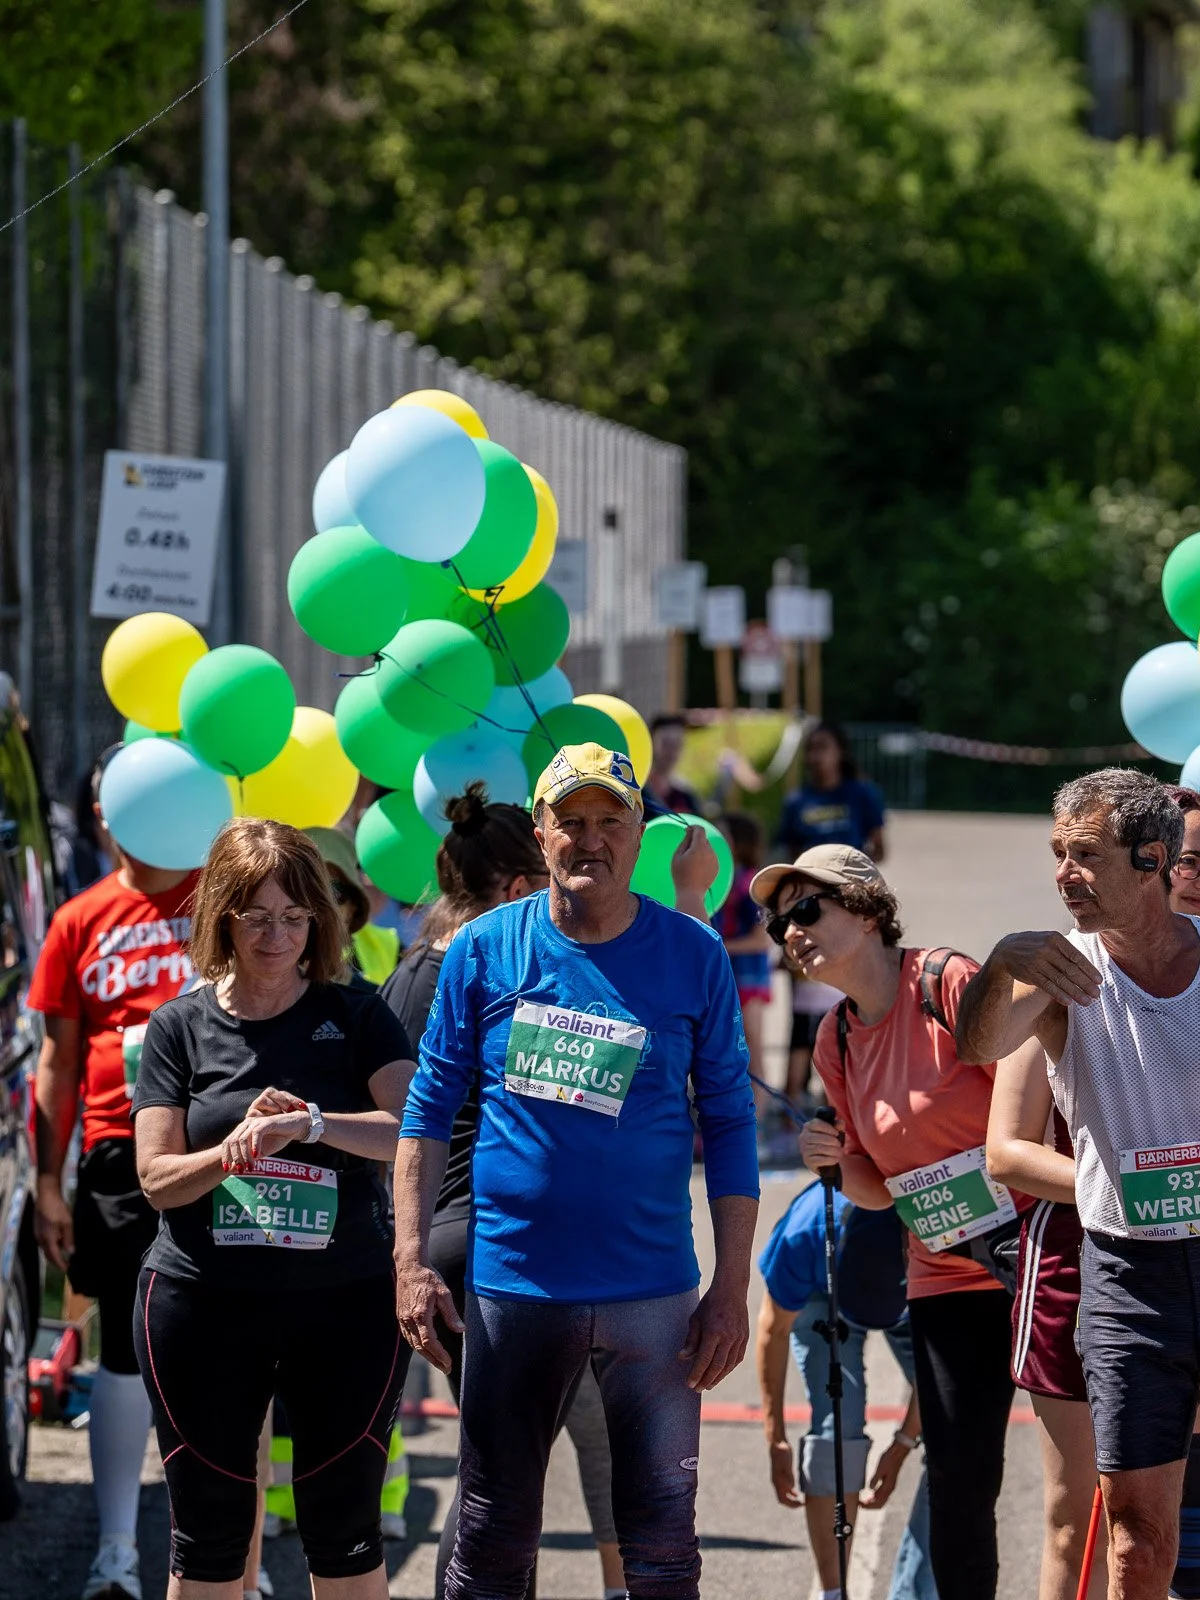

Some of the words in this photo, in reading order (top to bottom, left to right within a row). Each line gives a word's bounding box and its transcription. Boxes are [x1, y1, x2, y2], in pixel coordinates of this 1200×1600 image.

[82, 951, 193, 1002] Bern
[312, 1031, 345, 1041] adidas
[547, 1012, 615, 1040] valiant
[554, 1035, 595, 1060] 660
[515, 1051, 624, 1094] MARKUS
[252, 1161, 307, 1177] NERBÄR
[899, 1163, 954, 1194] valiant
[255, 1182, 292, 1202] 961
[911, 1185, 954, 1212] 1206
[219, 1204, 330, 1231] ISABELLE
[913, 1201, 973, 1236] IRENE
[223, 1231, 255, 1242] valiant
[1142, 1227, 1178, 1238] valiant
